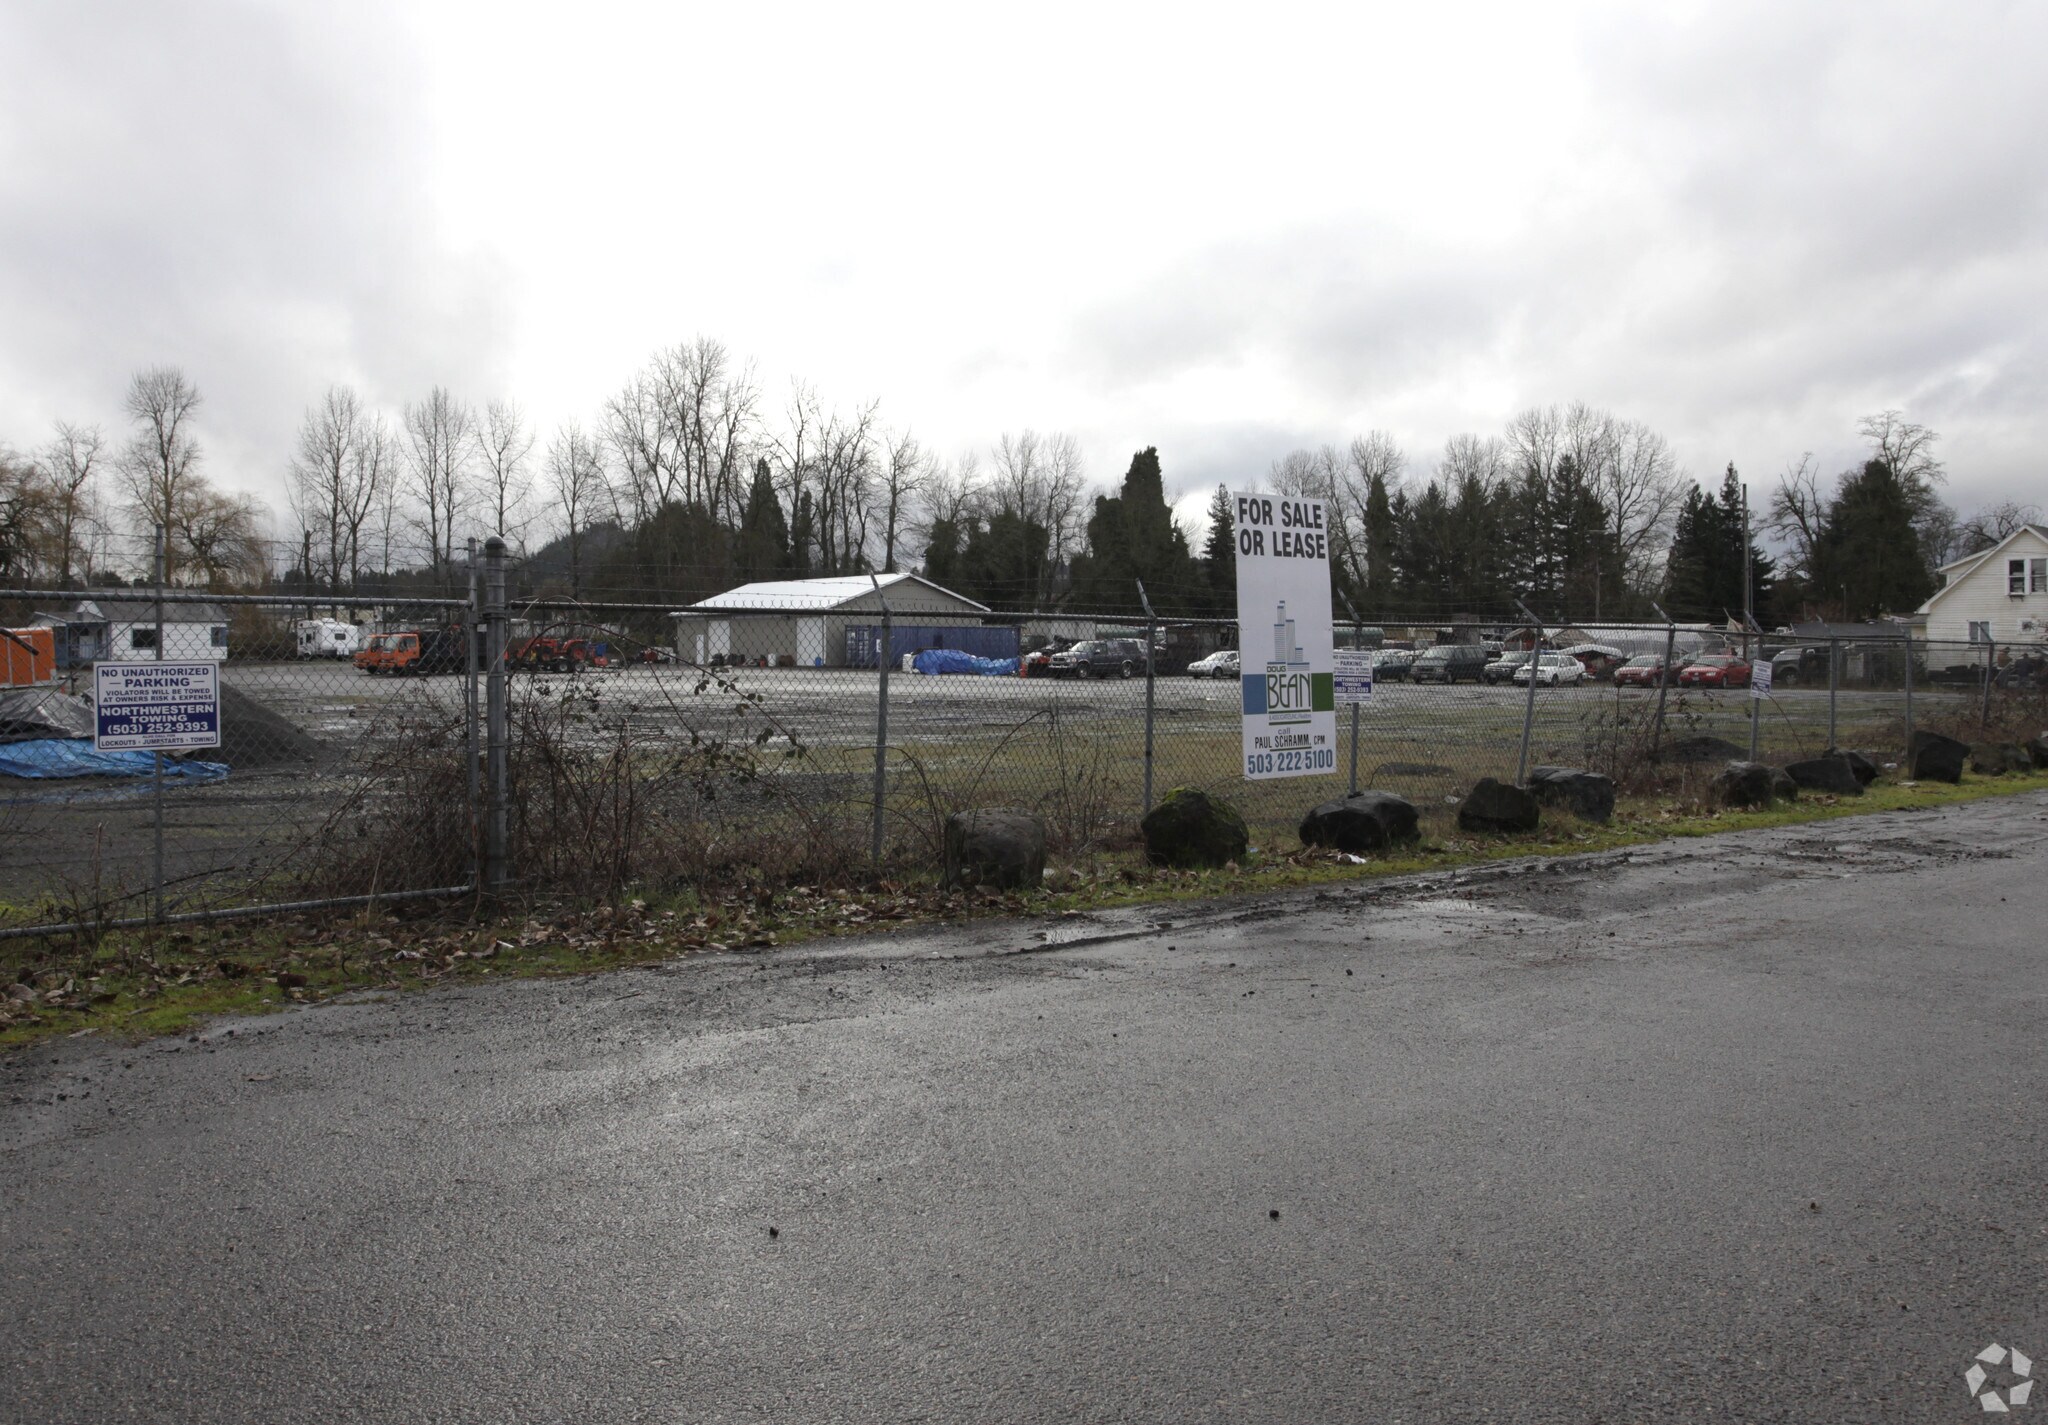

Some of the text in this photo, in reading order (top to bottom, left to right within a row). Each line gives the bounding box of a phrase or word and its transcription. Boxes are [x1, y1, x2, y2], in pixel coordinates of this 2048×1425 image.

[1238, 497, 1323, 529] FOR SALE
[1240, 528, 1326, 559] OR LEASE
[101, 667, 209, 678] NO UNAUTHORIZED
[124, 678, 190, 688] PARKING
[1267, 673, 1311, 709] BEAN
[101, 704, 214, 717] NORTHWESTERN
[130, 714, 188, 724] TOWING
[107, 722, 208, 734] (503) 252-9393
[1278, 727, 1291, 735] call
[1254, 736, 1272, 749] PAUL
[1314, 734, 1326, 746] CPM
